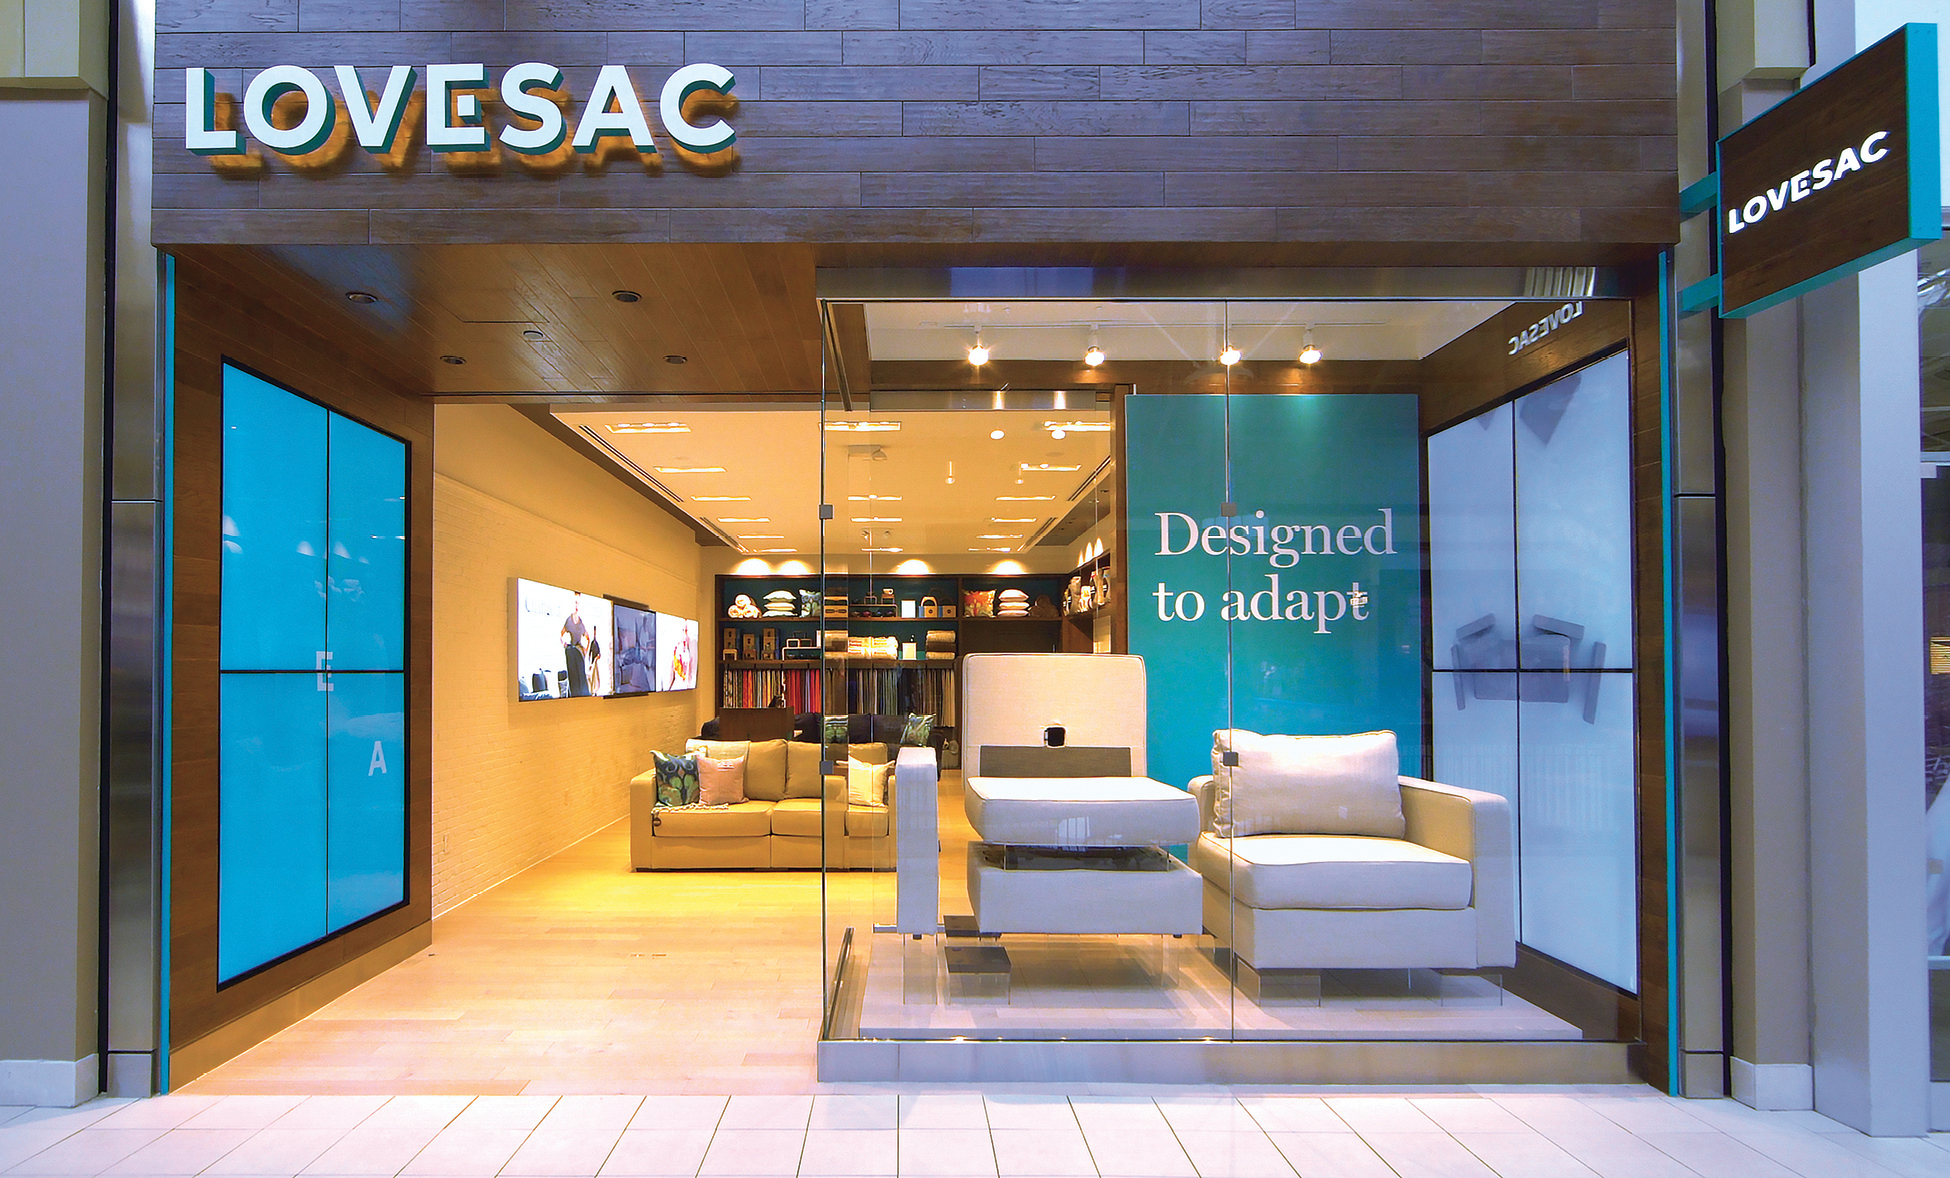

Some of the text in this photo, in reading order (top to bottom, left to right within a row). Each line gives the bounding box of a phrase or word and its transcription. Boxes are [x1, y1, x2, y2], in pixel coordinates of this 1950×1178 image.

[185, 62, 736, 153] LOVESAC
[1728, 130, 1890, 234] LOVESAC
[1154, 508, 1398, 568] Designed
[1152, 573, 1370, 634] to adapt
[315, 650, 334, 692] E
[367, 740, 387, 777] A
